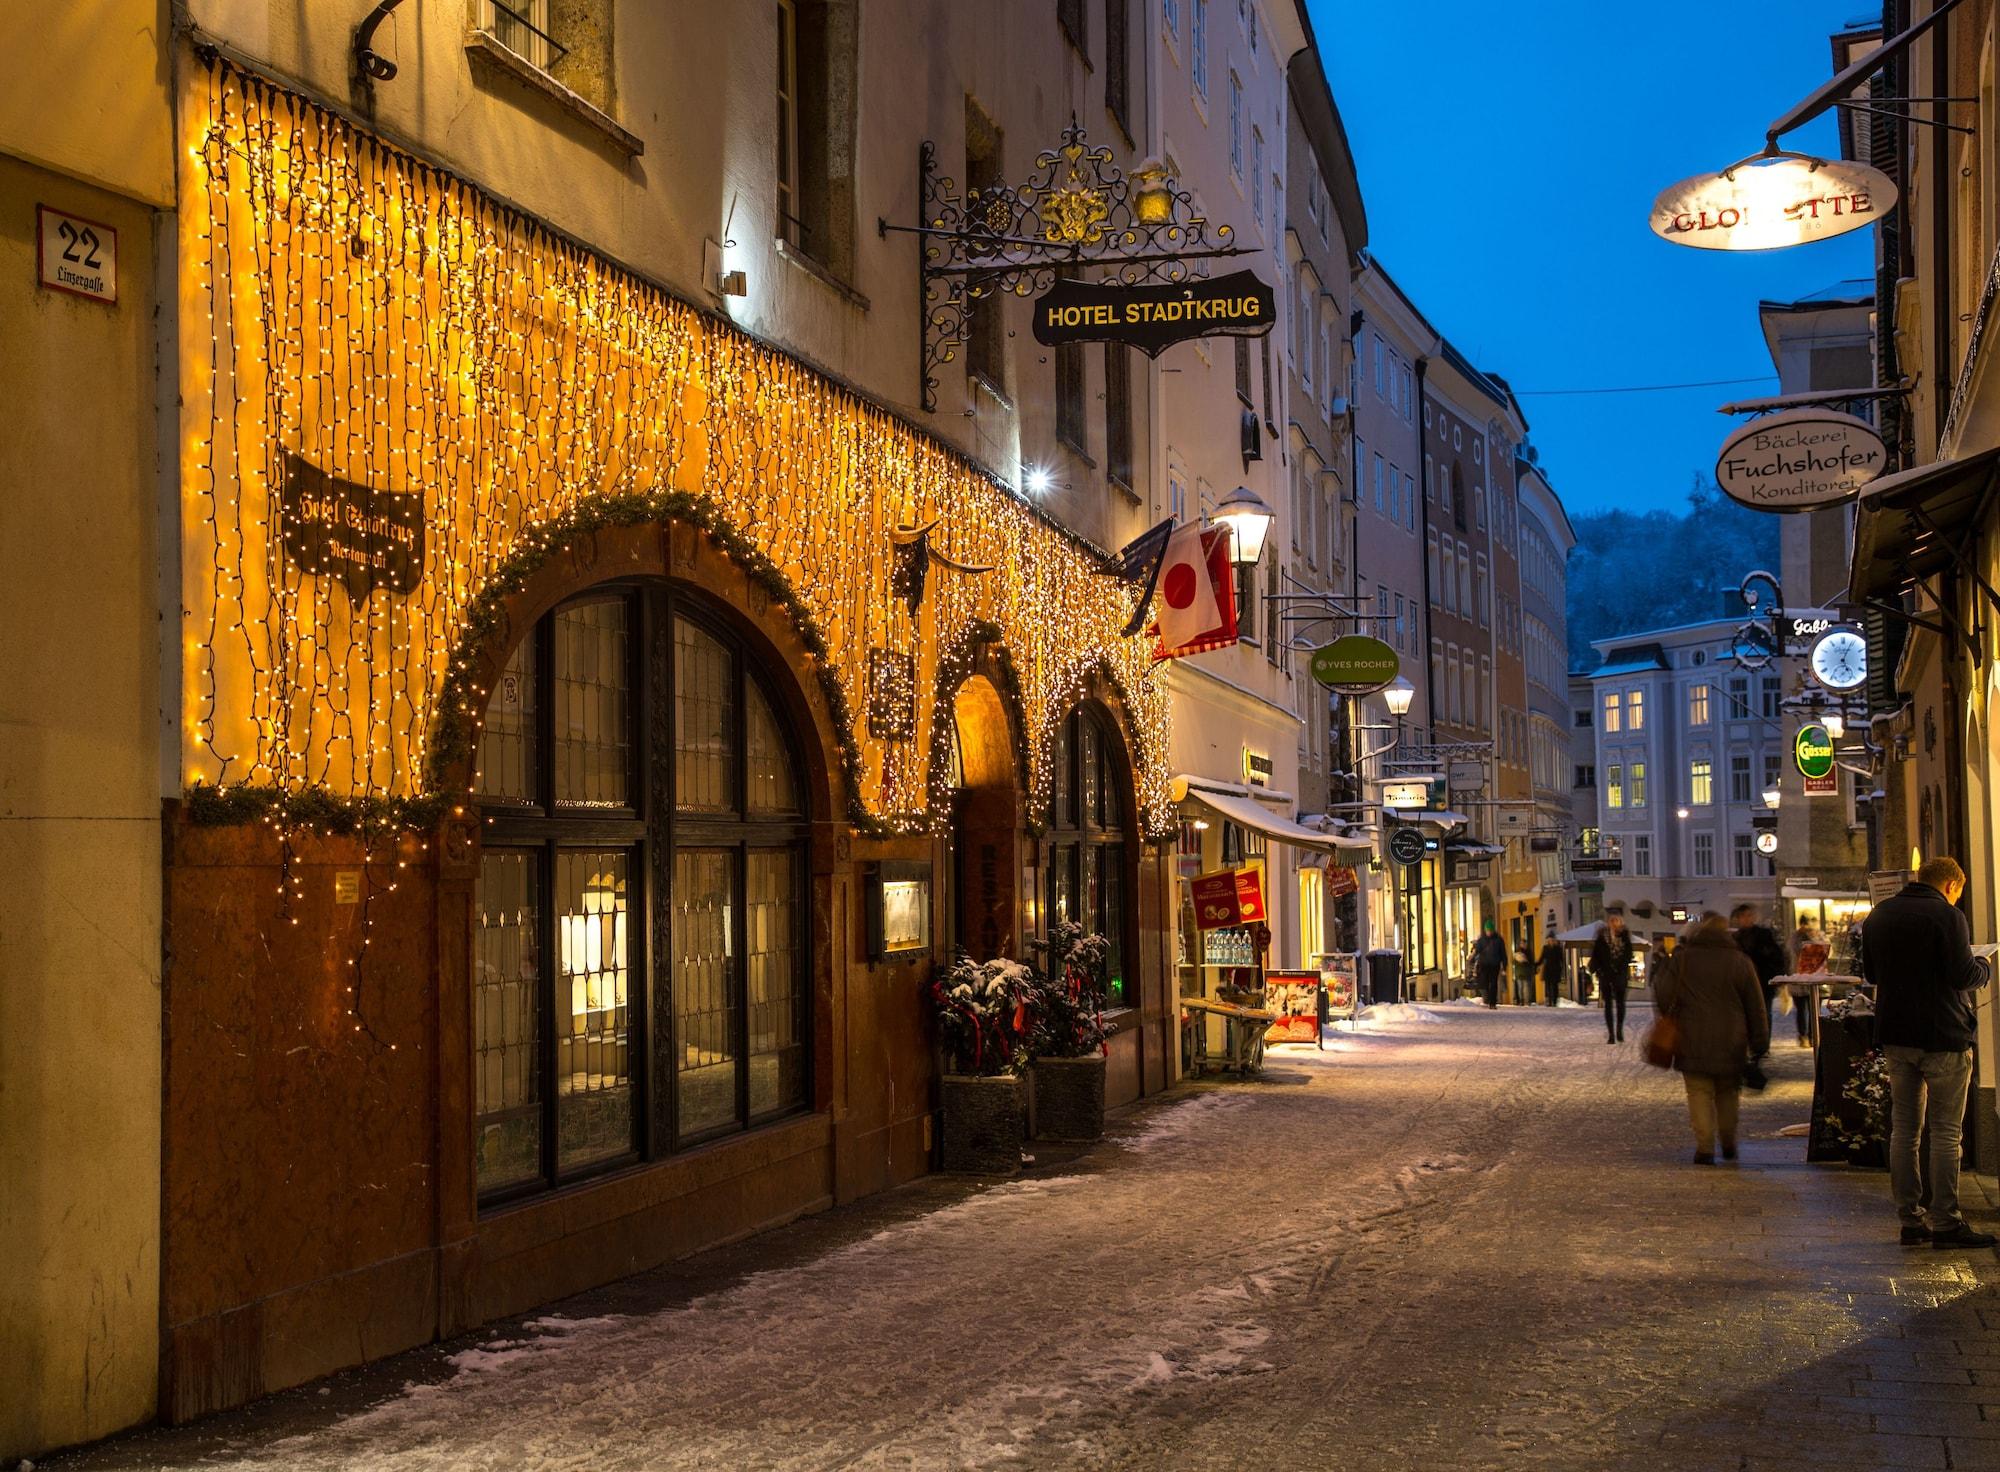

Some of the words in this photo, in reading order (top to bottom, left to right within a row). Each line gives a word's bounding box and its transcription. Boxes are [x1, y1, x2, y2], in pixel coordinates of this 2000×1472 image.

[1674, 193, 1875, 233] GLOTTE
[58, 220, 102, 270] 22
[1048, 304, 1121, 327] HOTEL
[1125, 296, 1260, 324] STADTKRUG
[1752, 427, 1848, 451] Bäckerei
[1724, 444, 1880, 480] Fuchshofer
[1751, 475, 1857, 500] Konditorei
[301, 493, 340, 525] Hotel
[1328, 660, 1352, 669] YVES
[1354, 660, 1395, 669] ROCHER
